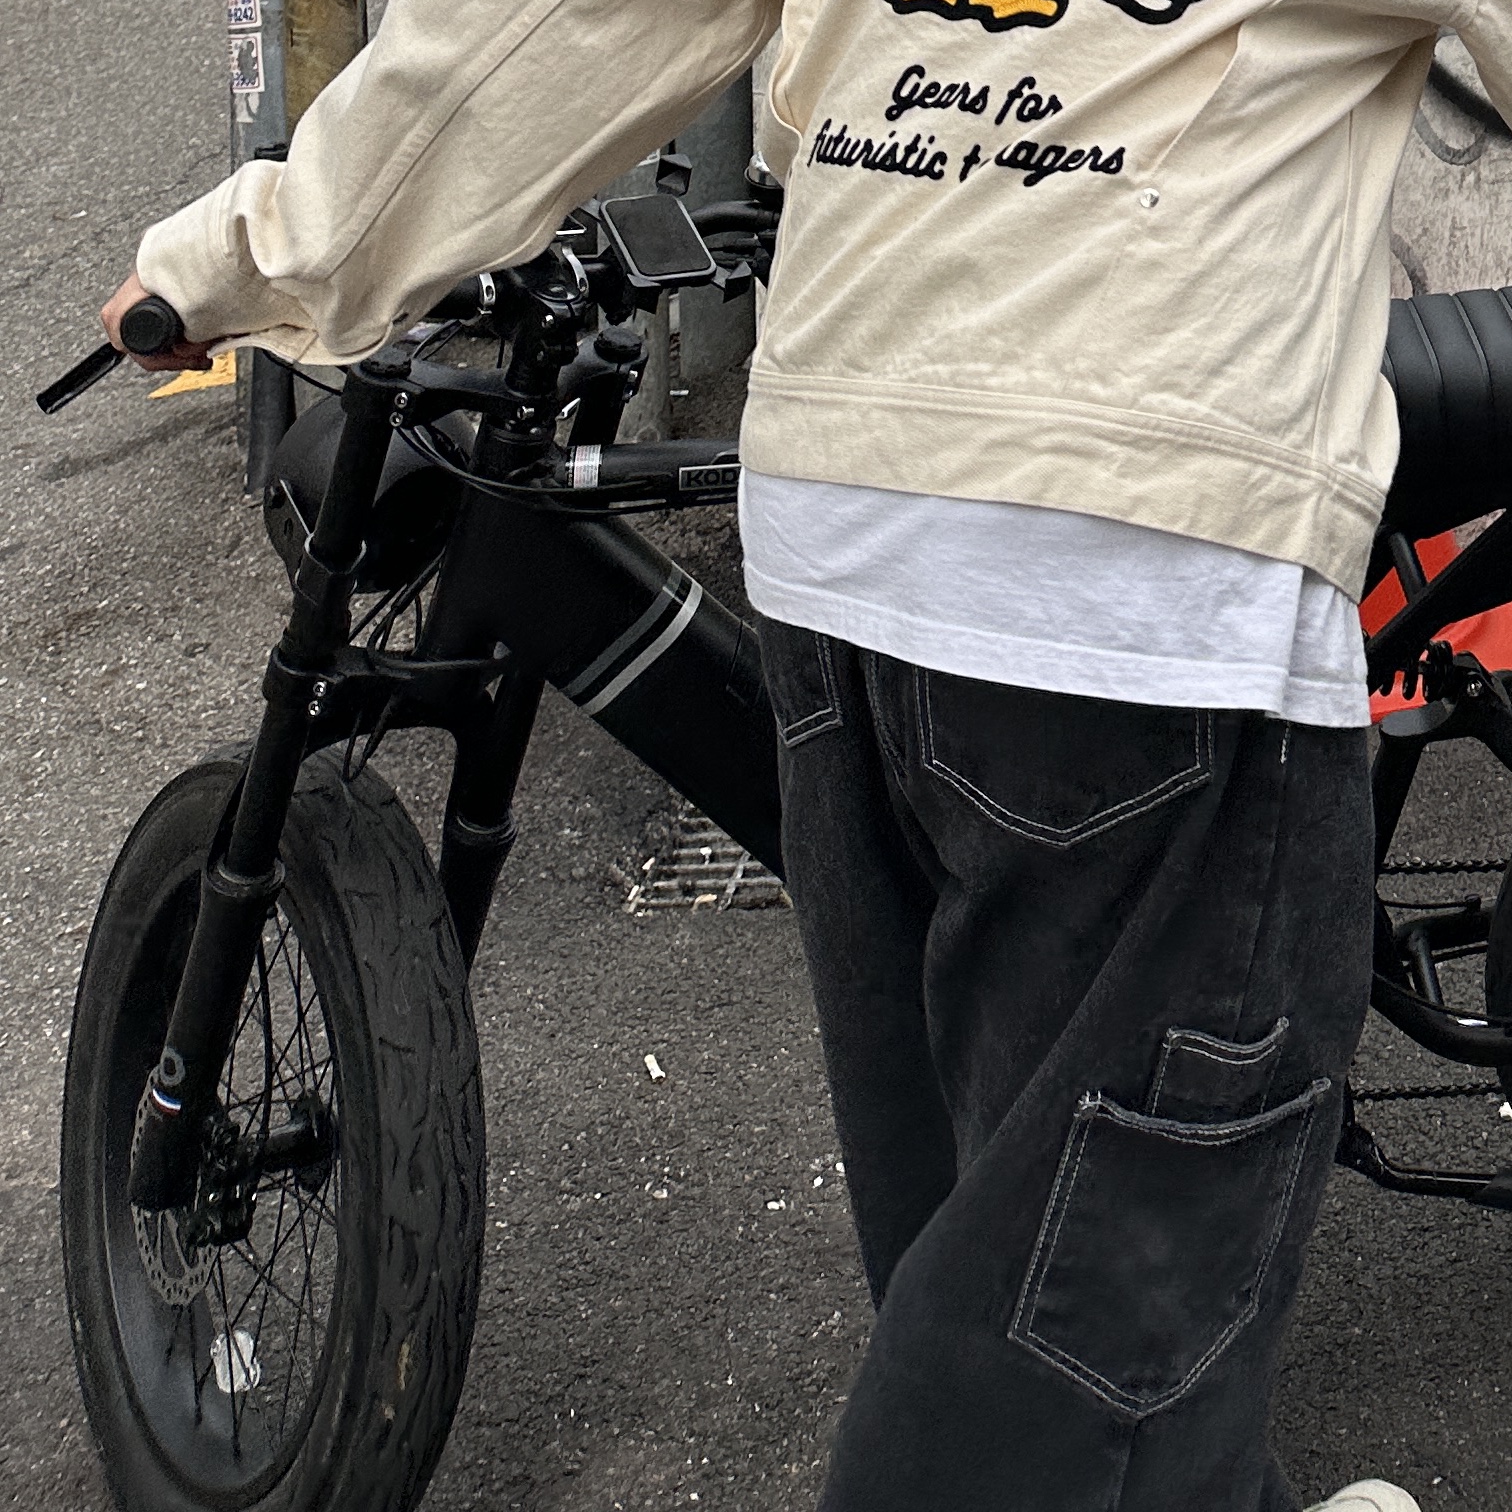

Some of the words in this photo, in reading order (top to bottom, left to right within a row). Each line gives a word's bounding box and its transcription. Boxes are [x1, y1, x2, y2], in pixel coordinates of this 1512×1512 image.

[884, 64, 990, 121] Gears
[994, 76, 1064, 125] for
[807, 118, 948, 180] futuristic
